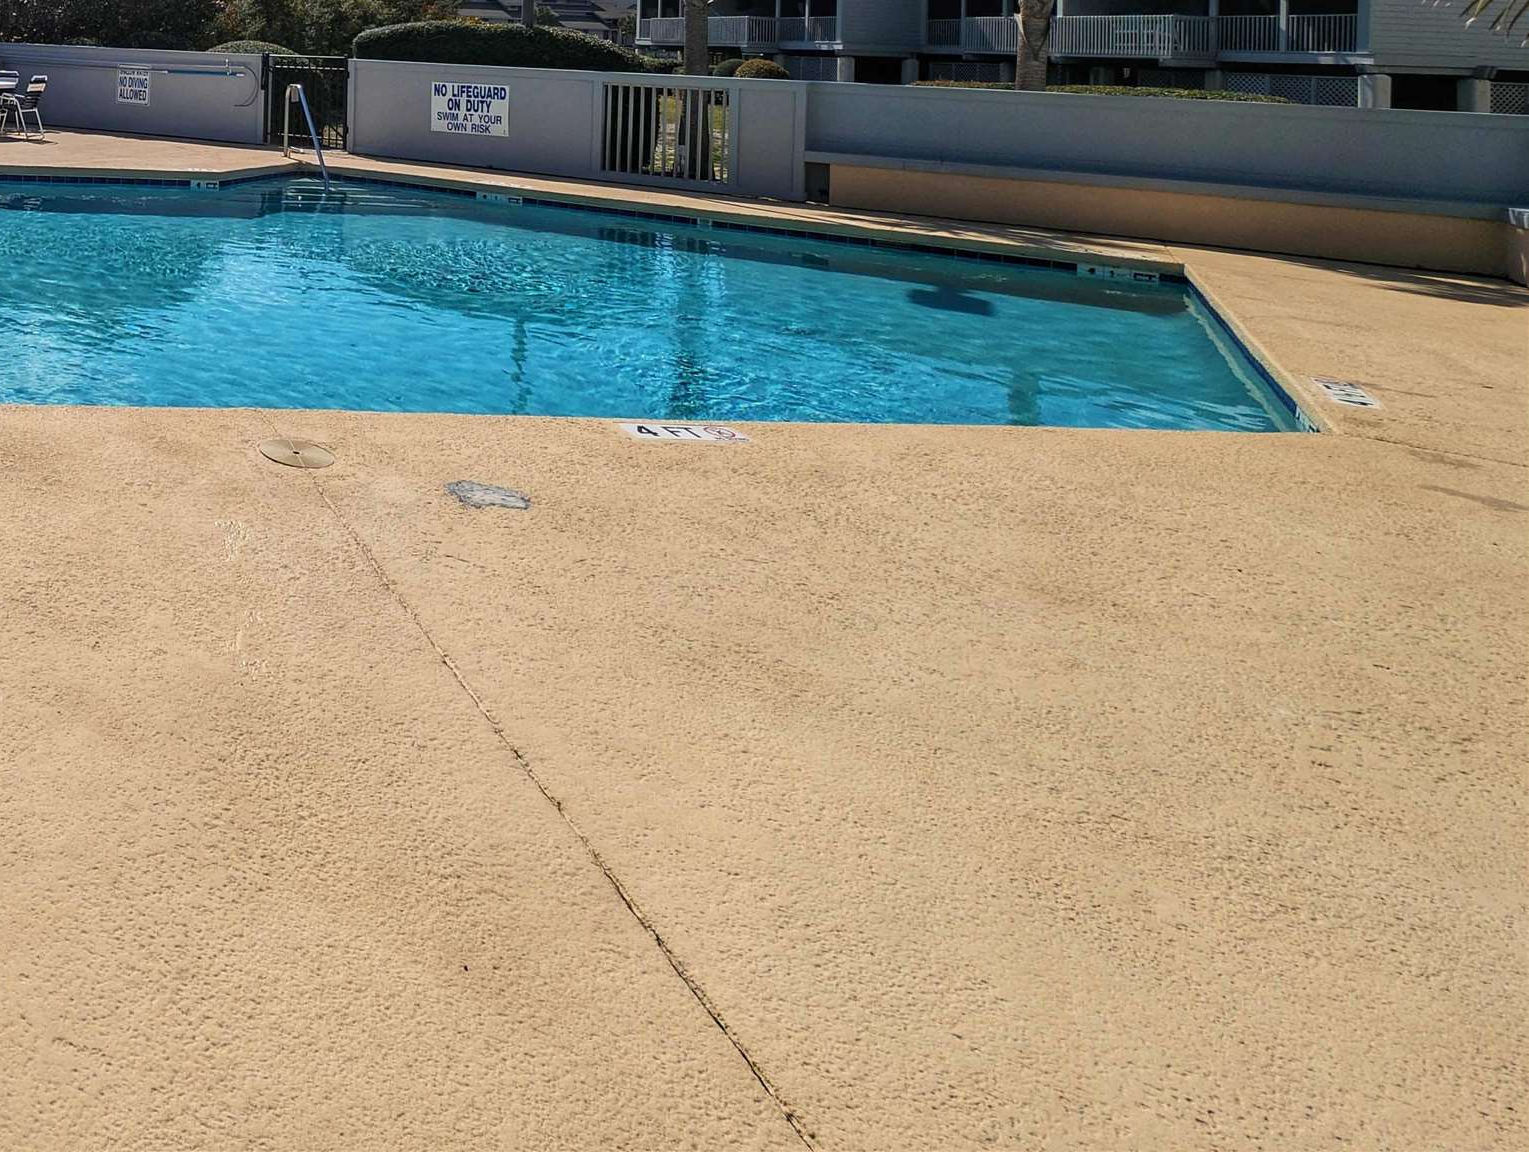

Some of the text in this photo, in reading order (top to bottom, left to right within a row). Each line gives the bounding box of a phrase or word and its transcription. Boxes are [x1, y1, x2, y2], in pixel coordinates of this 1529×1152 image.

[119, 76, 148, 89] NO DIVING
[119, 88, 147, 101] ALLOWED
[433, 84, 507, 101] NO LIFEGUARD
[447, 98, 492, 113] ON DUTY
[436, 111, 502, 125] SWIM AT YOUR
[446, 121, 491, 134] OWN RISK
[636, 425, 702, 439] 4 FT
